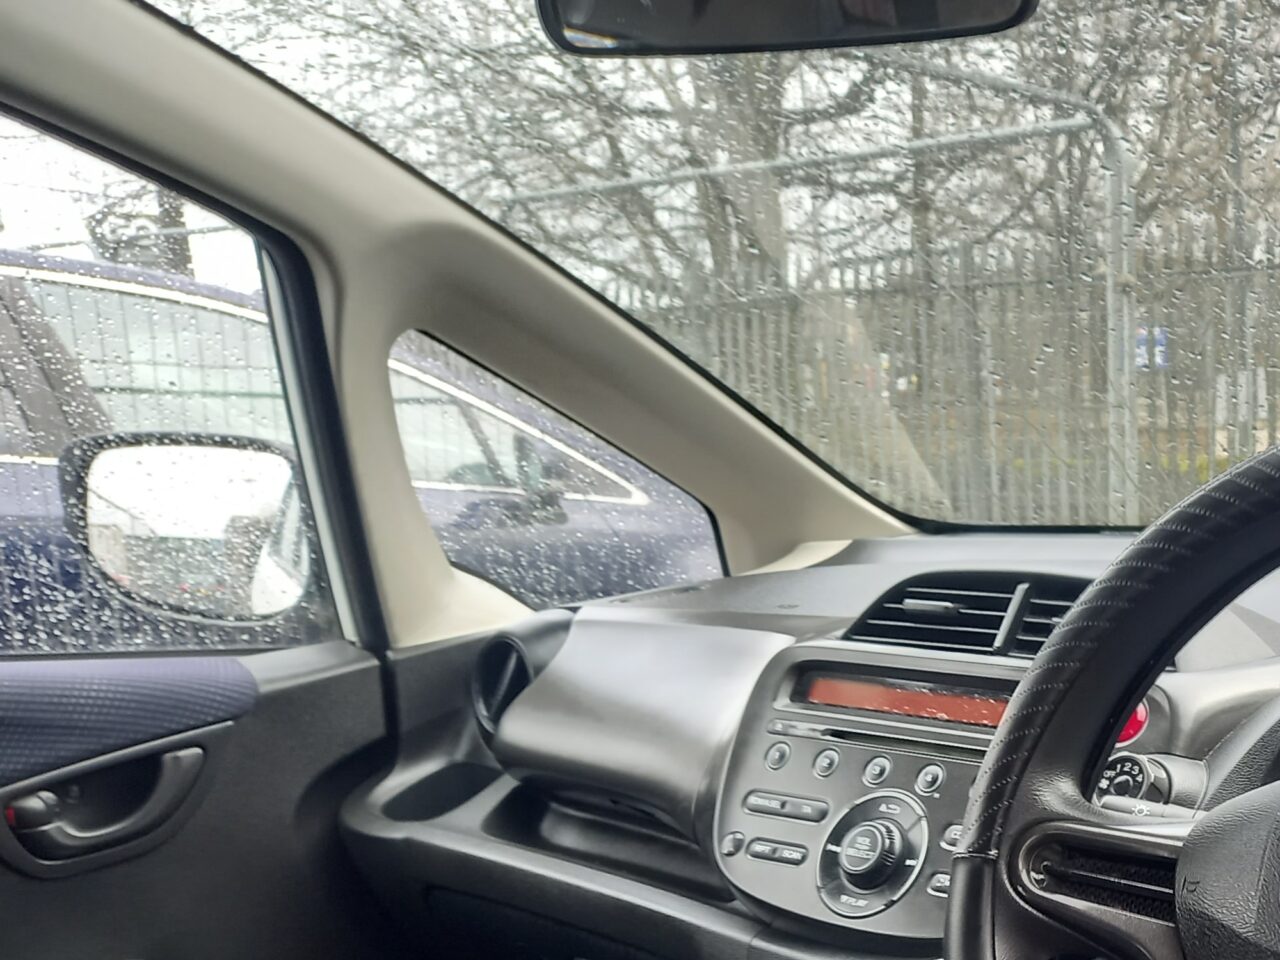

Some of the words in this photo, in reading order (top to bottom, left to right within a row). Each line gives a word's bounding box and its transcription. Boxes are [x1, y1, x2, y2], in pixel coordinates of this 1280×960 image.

[1116, 764, 1121, 773] 1
[1123, 762, 1132, 771] 2
[1131, 766, 1140, 775] 3
[1135, 774, 1143, 782] 4
[782, 849, 803, 861] SCAN
